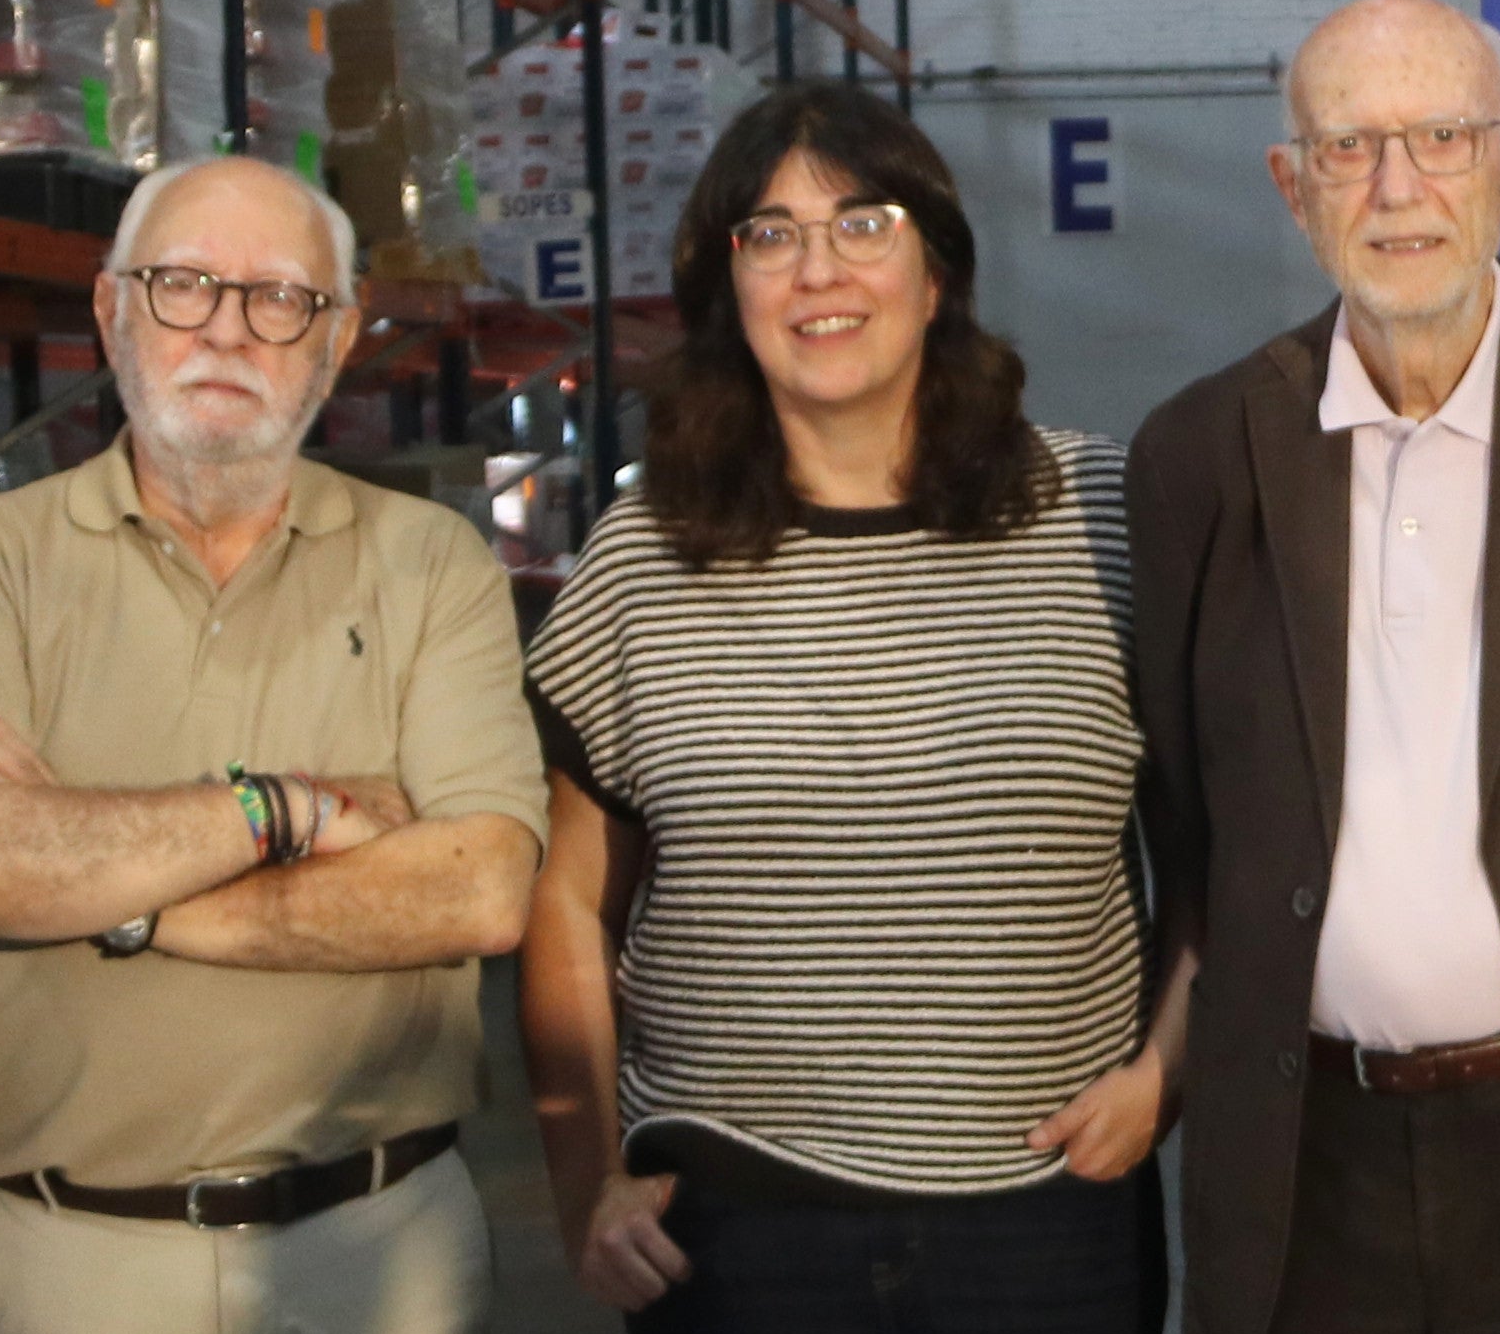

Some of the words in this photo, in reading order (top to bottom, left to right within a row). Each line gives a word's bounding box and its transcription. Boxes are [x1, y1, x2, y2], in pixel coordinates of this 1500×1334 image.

[1050, 117, 1113, 232] E
[500, 192, 573, 218] SOPES
[536, 239, 585, 299] E
